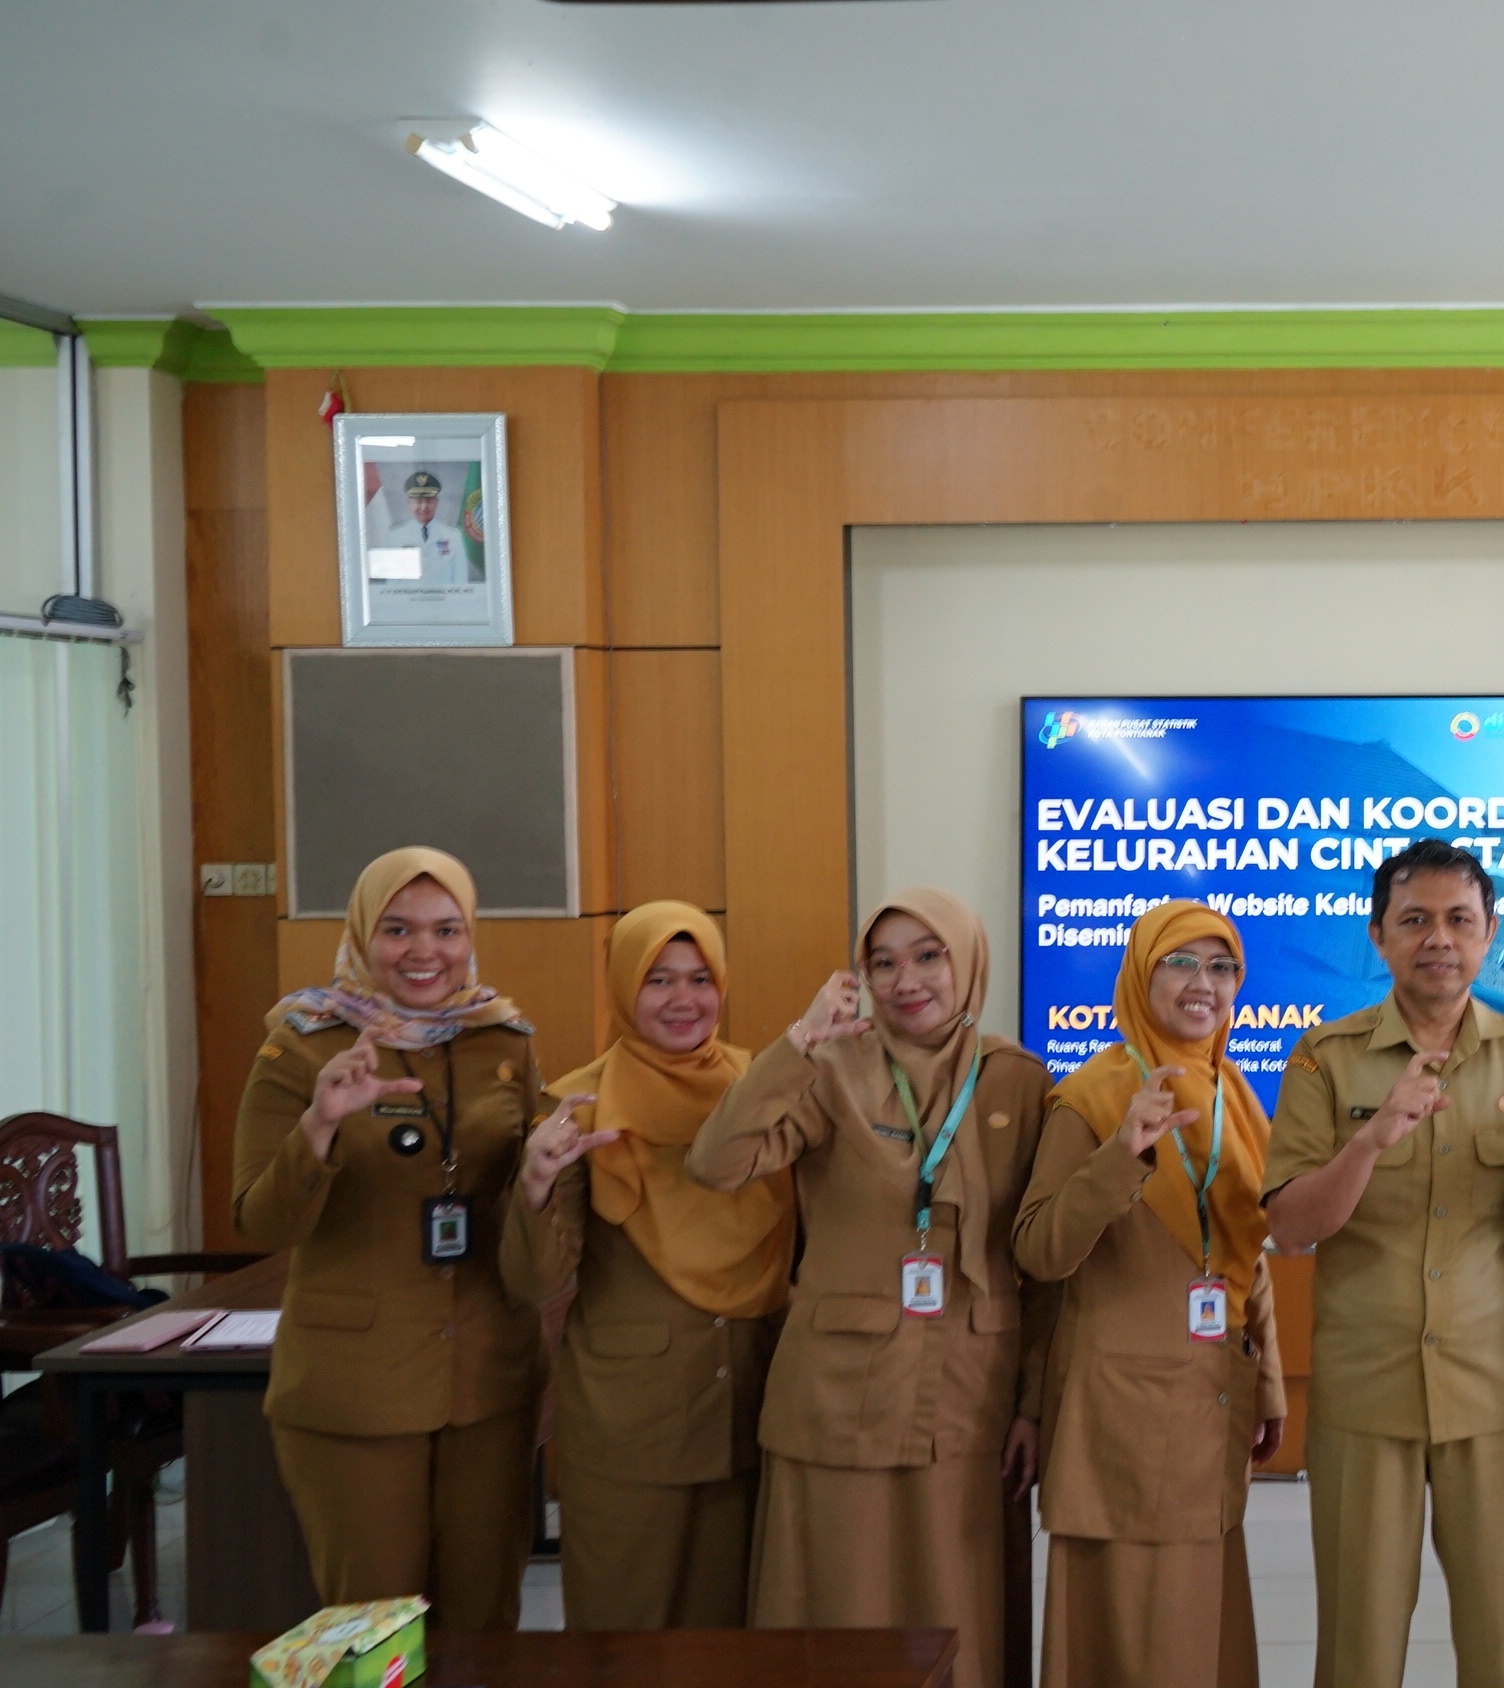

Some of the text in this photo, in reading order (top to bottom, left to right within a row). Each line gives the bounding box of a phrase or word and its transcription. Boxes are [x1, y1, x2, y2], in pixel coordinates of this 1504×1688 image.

[1113, 729, 1166, 738] PONTIANAK
[1121, 719, 1152, 729] PUSAT
[1152, 718, 1197, 729] STATISTIK
[1038, 798, 1244, 830] EVALUASI
[1257, 797, 1349, 830] DAN
[1038, 838, 1299, 871] KELURAHAN
[1310, 837, 1410, 870] CINT
[1207, 892, 1309, 917] Website
[1048, 1004, 1119, 1030] KOT
[1047, 1038, 1088, 1056] Ruang
[1228, 1038, 1282, 1053] Sektoral
